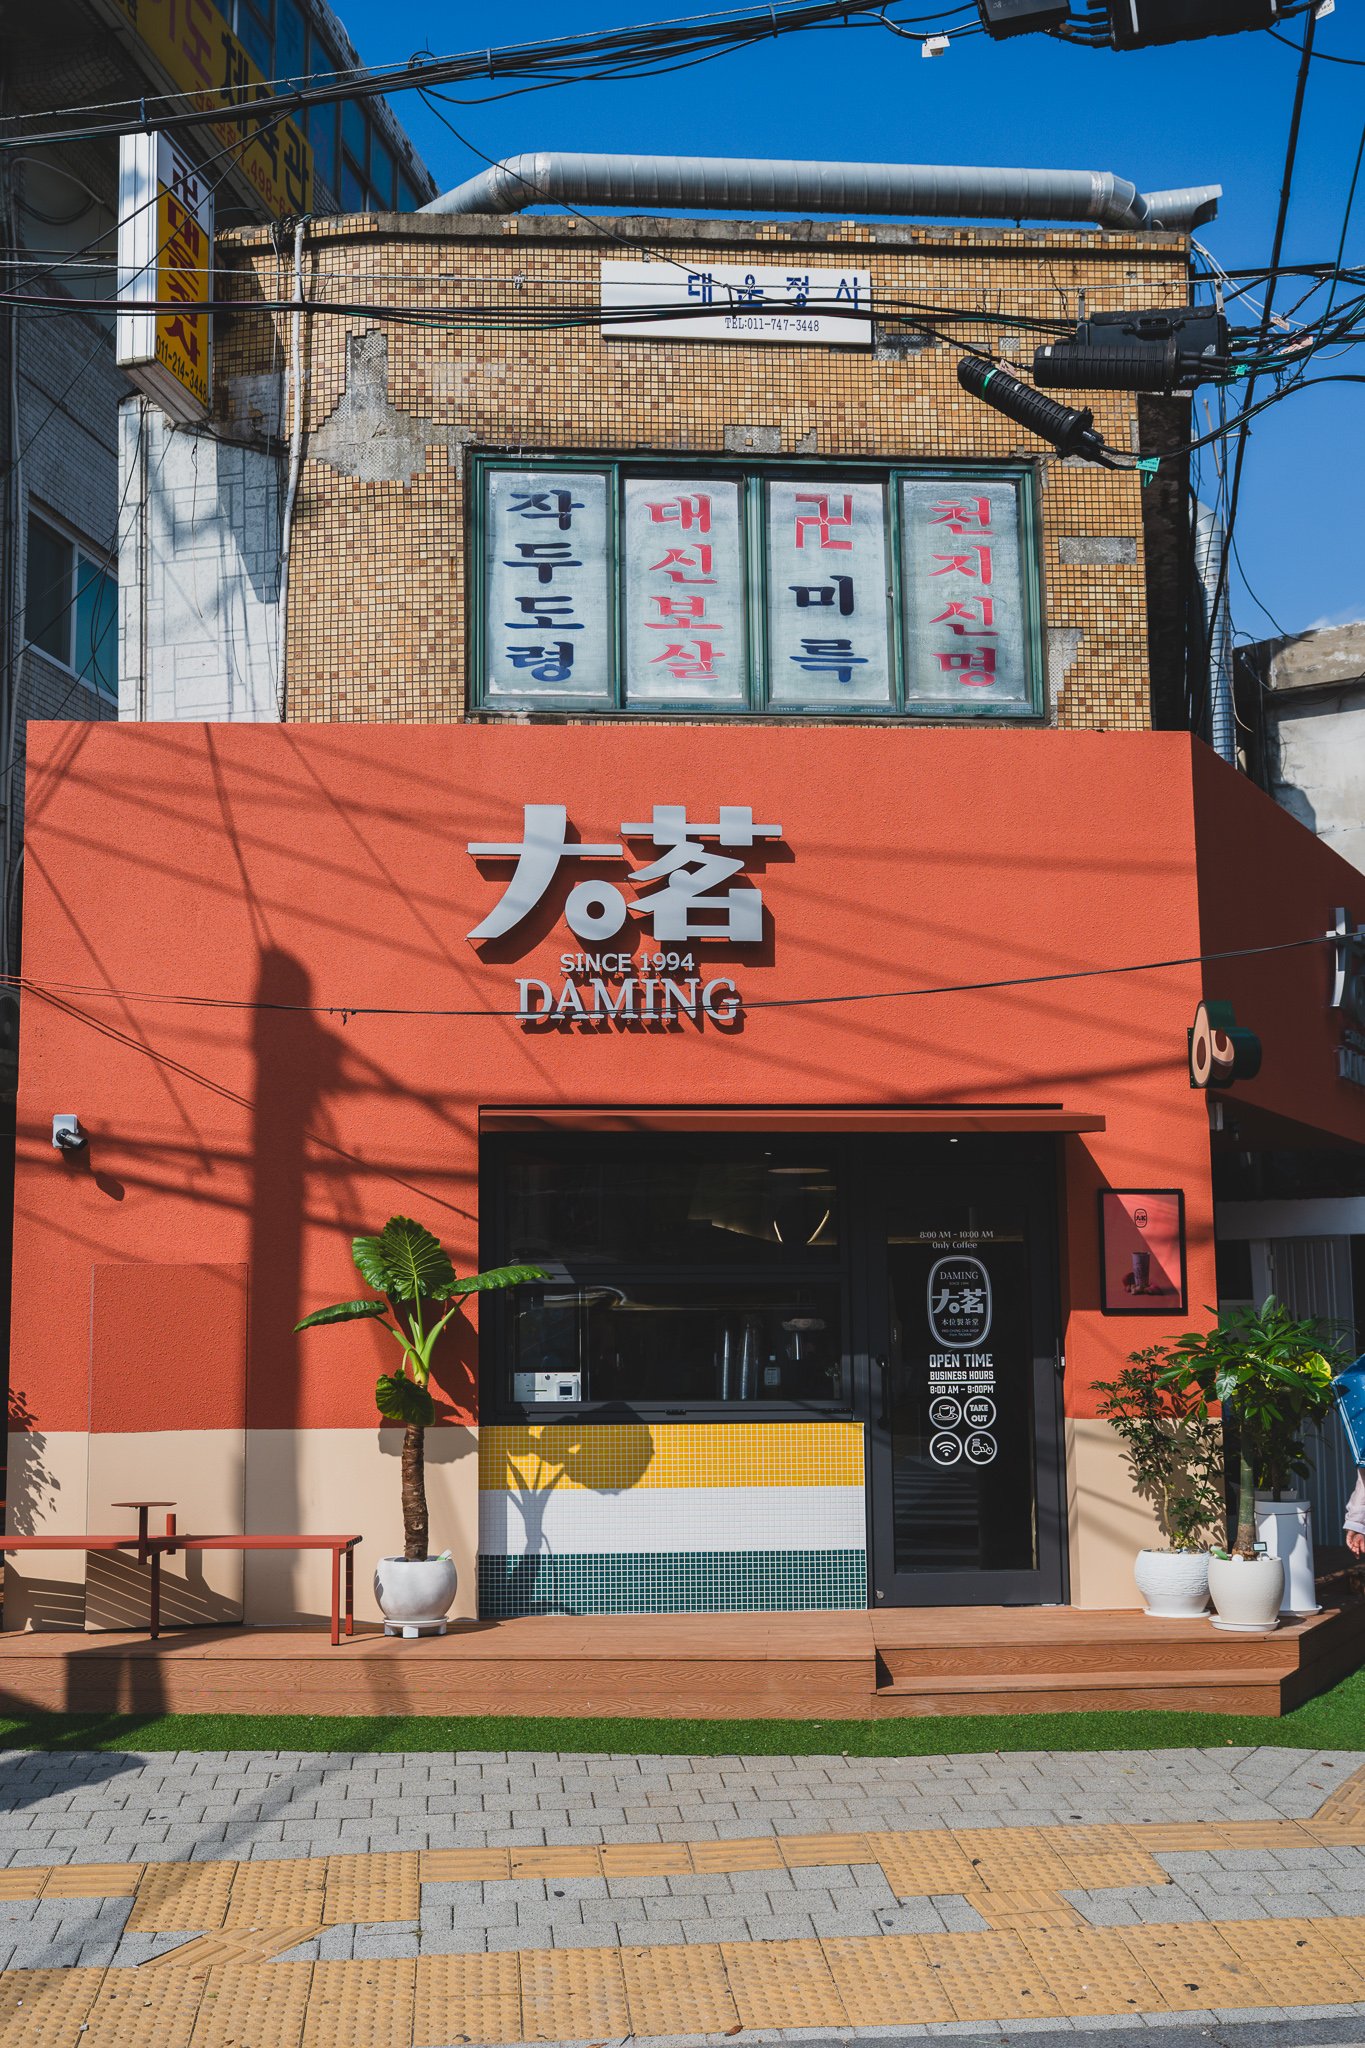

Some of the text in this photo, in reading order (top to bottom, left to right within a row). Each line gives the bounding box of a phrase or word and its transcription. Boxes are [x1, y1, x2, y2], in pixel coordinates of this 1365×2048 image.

[725, 317, 819, 332] TEL:011-747-3448
[156, 335, 208, 403] 011-214-3448
[502, 489, 585, 682] 작두도령
[643, 492, 726, 680] 대신보살
[928, 495, 999, 688] 천지신명
[560, 952, 695, 972] SINCE 1994
[514, 977, 739, 1020] DAMING
[932, 1241, 978, 1250] Only Coffee
[940, 1271, 979, 1280] DAMING
[929, 1353, 993, 1367] OPEN TIME
[930, 1370, 994, 1380] BUSINESS HOURS
[929, 1385, 946, 1394] 8:00
[947, 1385, 959, 1394] AM
[970, 1414, 988, 1422] OUT
